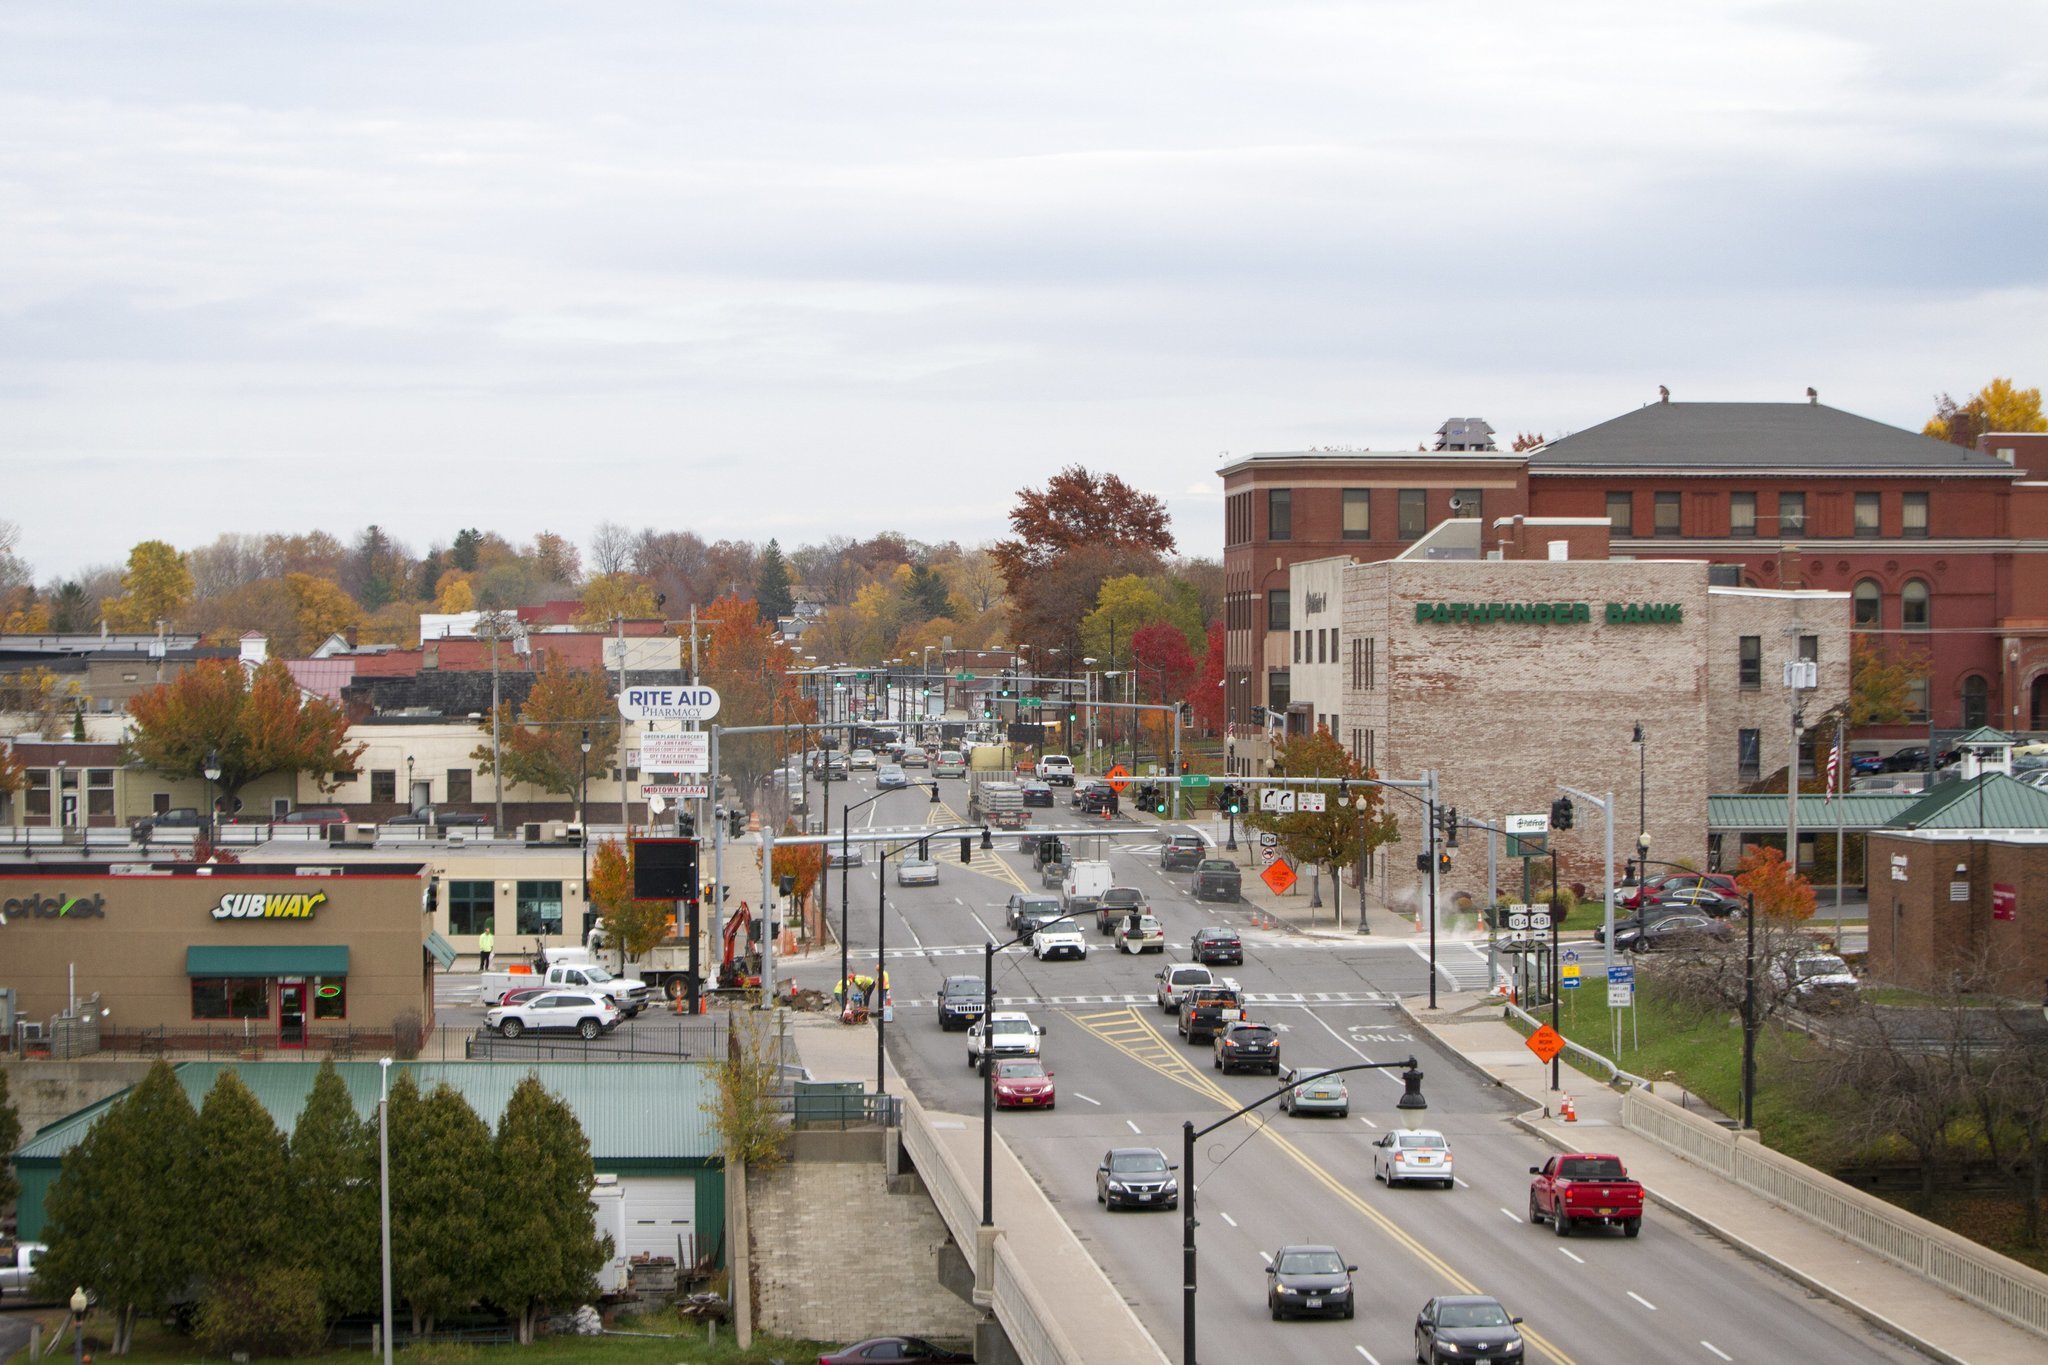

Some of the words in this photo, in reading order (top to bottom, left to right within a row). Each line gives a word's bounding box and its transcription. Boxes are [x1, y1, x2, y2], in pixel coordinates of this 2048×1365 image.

[1416, 603, 1591, 625] PATHFINDER
[1605, 603, 1683, 625] BANK
[629, 691, 673, 706] RITE
[678, 691, 712, 706] AID
[642, 706, 702, 717] PHARMACY
[681, 786, 706, 794] PLAZA
[4, 893, 105, 919] cricket
[212, 893, 327, 919] SUBWAY
[1510, 918, 1527, 926] 104
[1533, 917, 1549, 925] 481
[1351, 1034, 1415, 1042] ONLY
